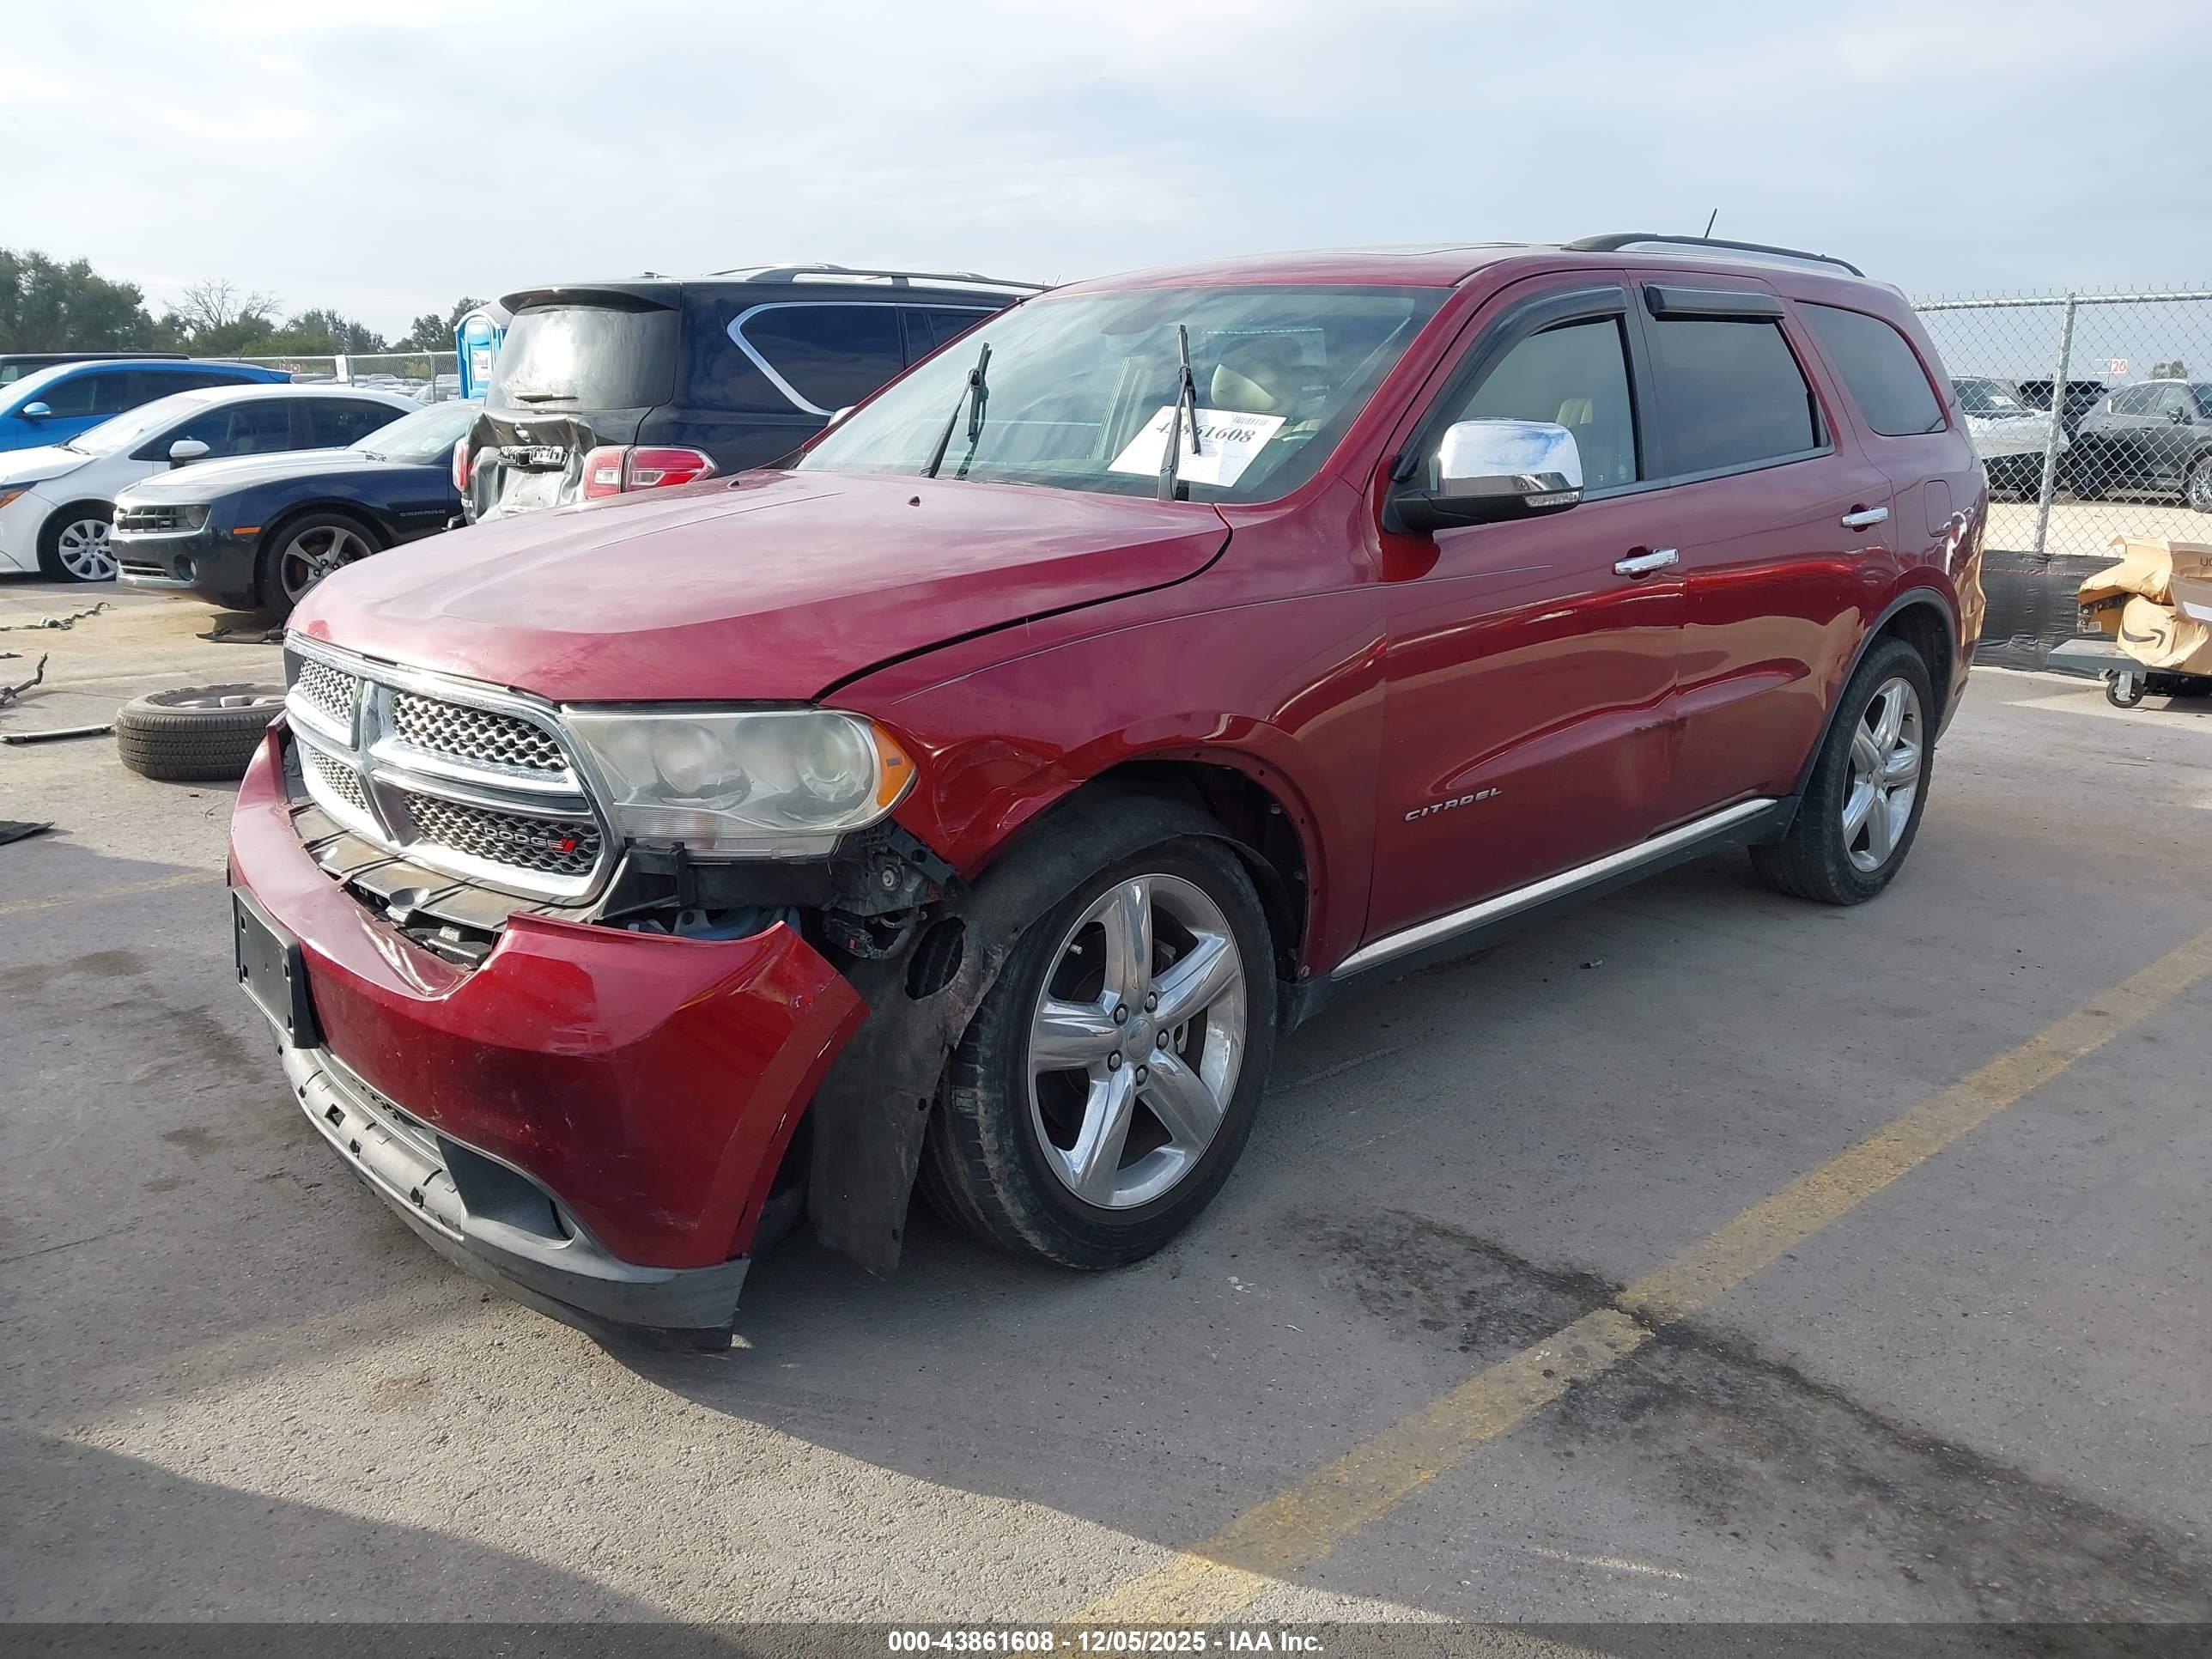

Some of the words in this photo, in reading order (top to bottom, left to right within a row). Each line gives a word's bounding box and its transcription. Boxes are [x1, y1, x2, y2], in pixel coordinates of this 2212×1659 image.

[2113, 361, 2126, 372] 20
[1404, 787, 1503, 822] CITADEL
[484, 827, 564, 849] DODGE
